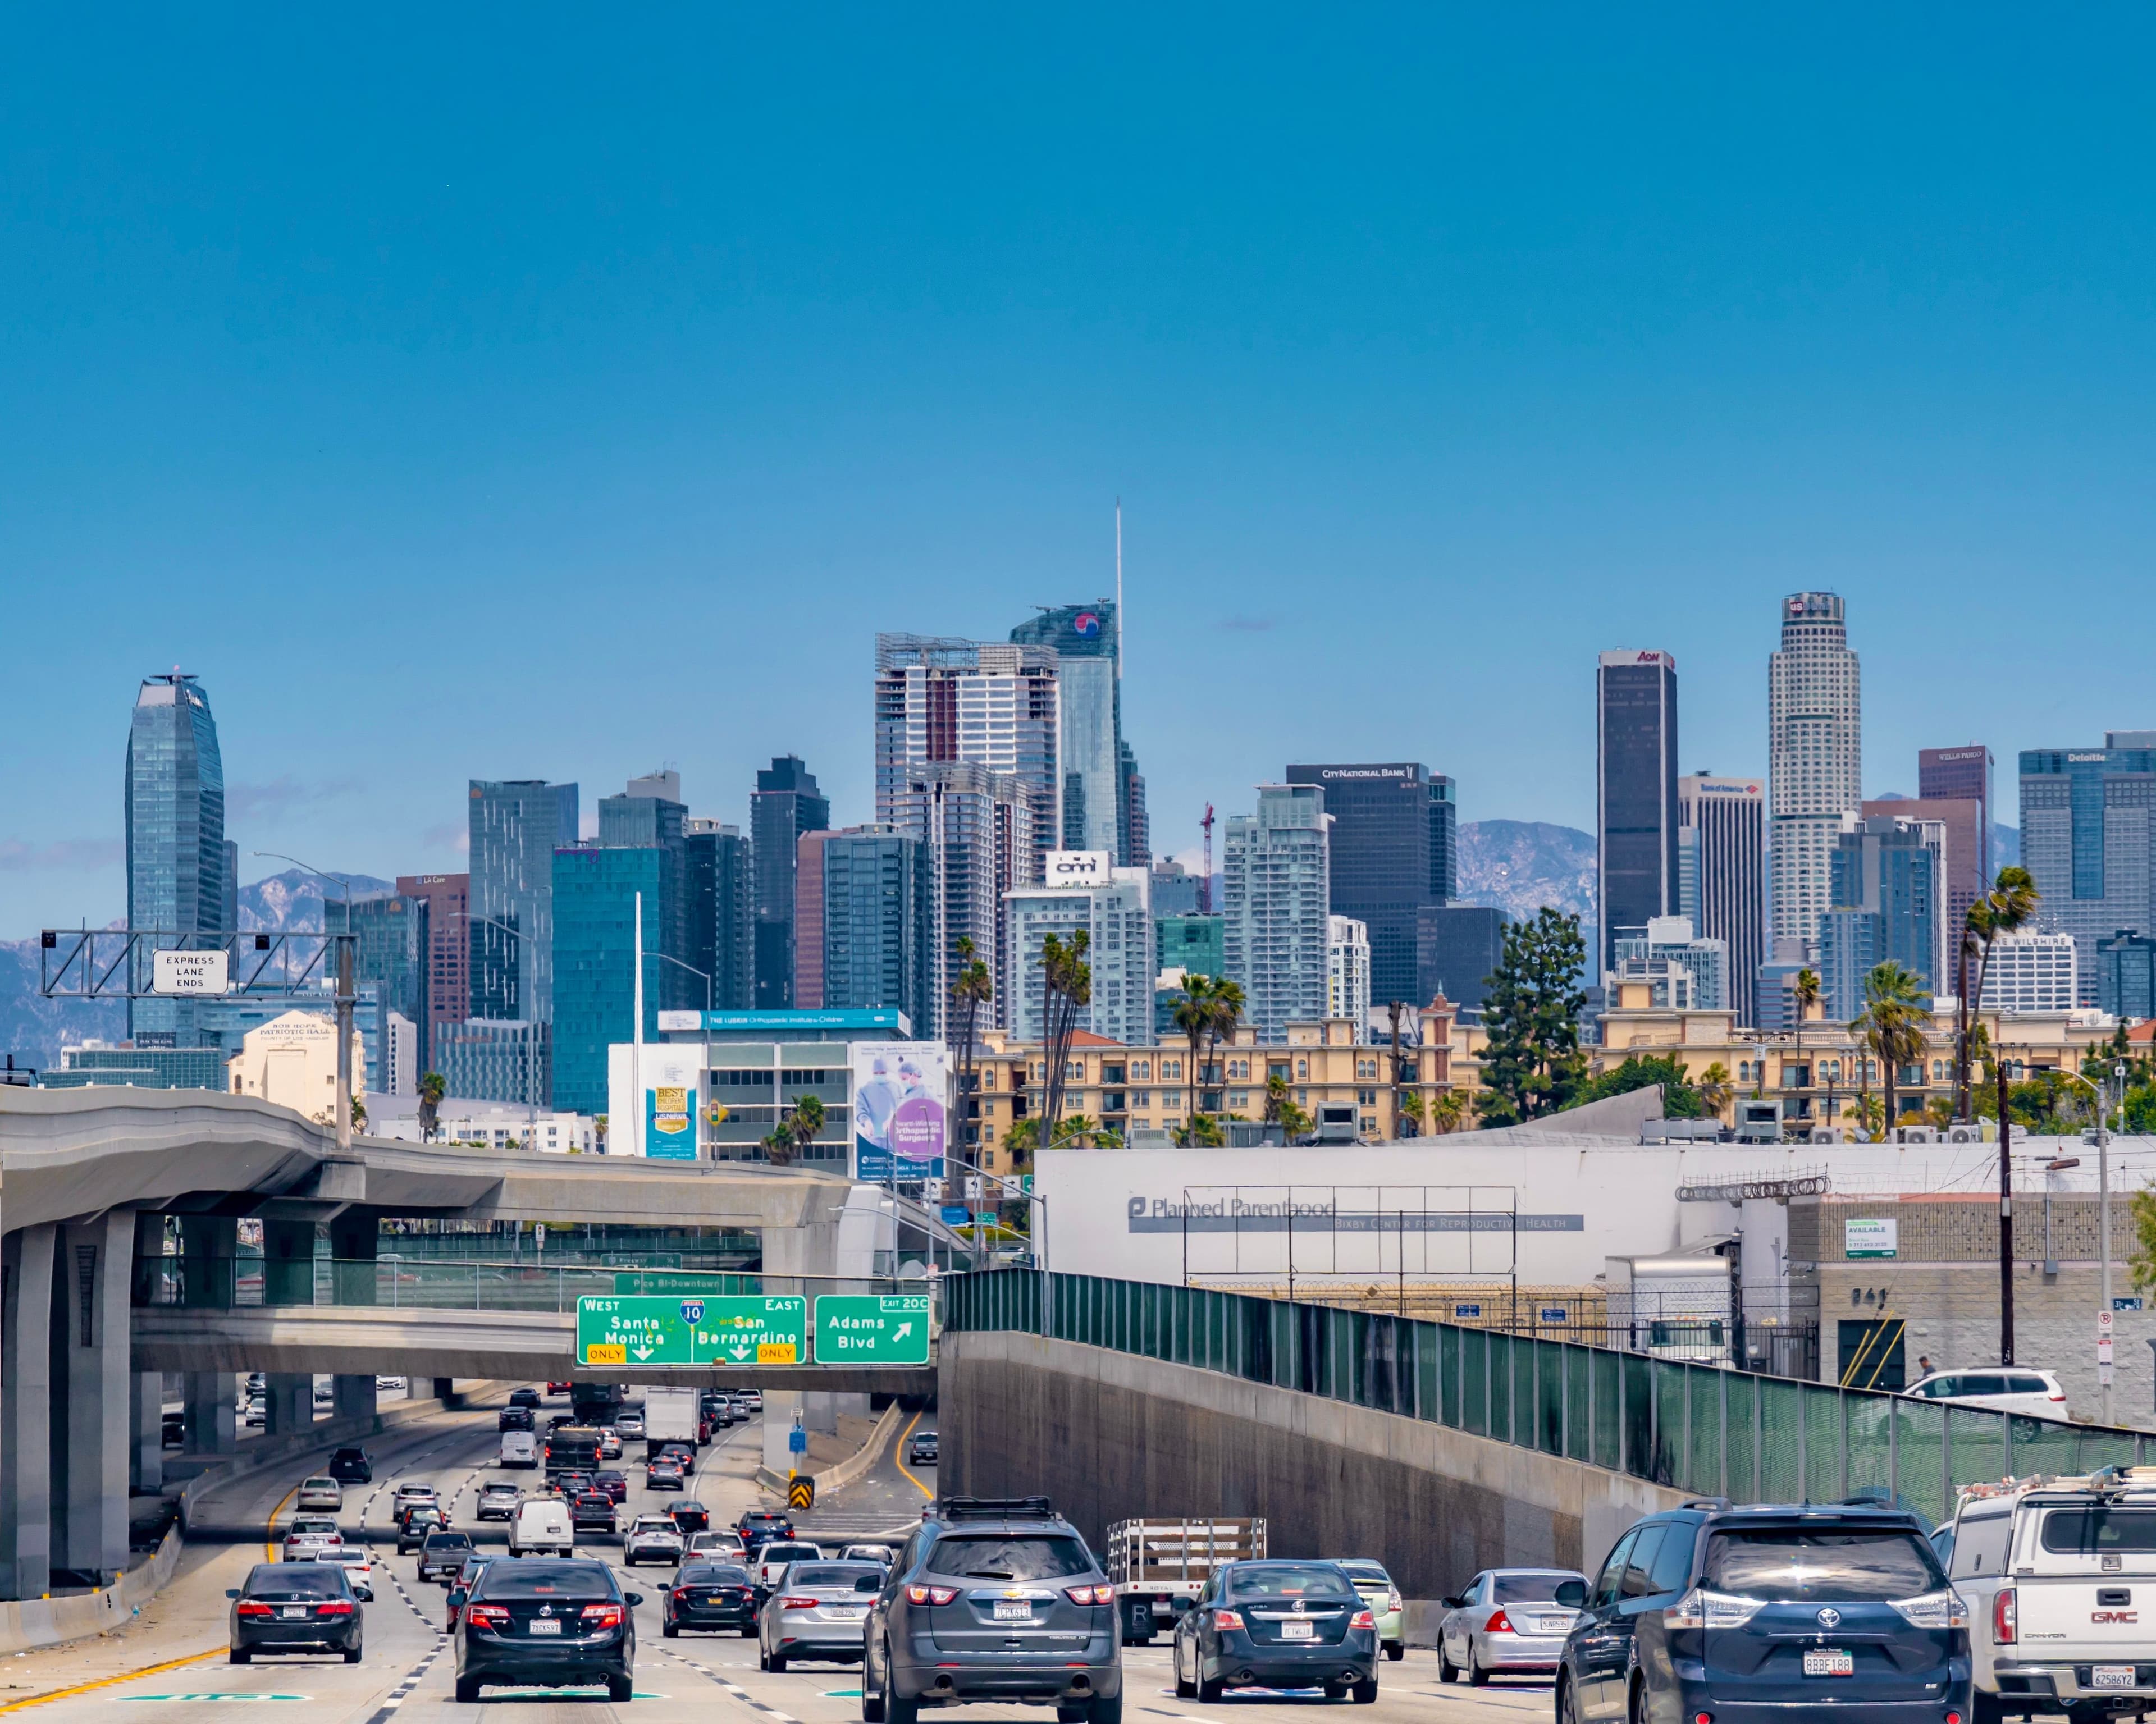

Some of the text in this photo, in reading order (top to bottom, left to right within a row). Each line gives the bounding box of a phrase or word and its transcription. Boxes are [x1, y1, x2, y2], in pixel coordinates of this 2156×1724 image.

[1382, 769, 1405, 777] BANK
[658, 1088, 686, 1097] BEST
[1153, 1197, 1336, 1218] Planned Parenthood
[1335, 1218, 1365, 1229] BIXBY
[1526, 1218, 1566, 1228] HEALTH
[584, 1299, 620, 1311] WEST
[765, 1299, 800, 1311] EAST
[902, 1298, 928, 1309] 20C
[686, 1306, 700, 1319] 10
[611, 1316, 659, 1329] Santa
[734, 1315, 765, 1329] San
[829, 1315, 885, 1329] Adams
[605, 1332, 664, 1345] Monica
[698, 1332, 797, 1345] Bernardino
[838, 1336, 875, 1348] Blvd
[590, 1350, 623, 1359] ONLY
[760, 1348, 792, 1358] ONLY
[1134, 1605, 1147, 1622] R
[2091, 1611, 2138, 1624] GMC
[2095, 1674, 2132, 1685] 62586Y2
